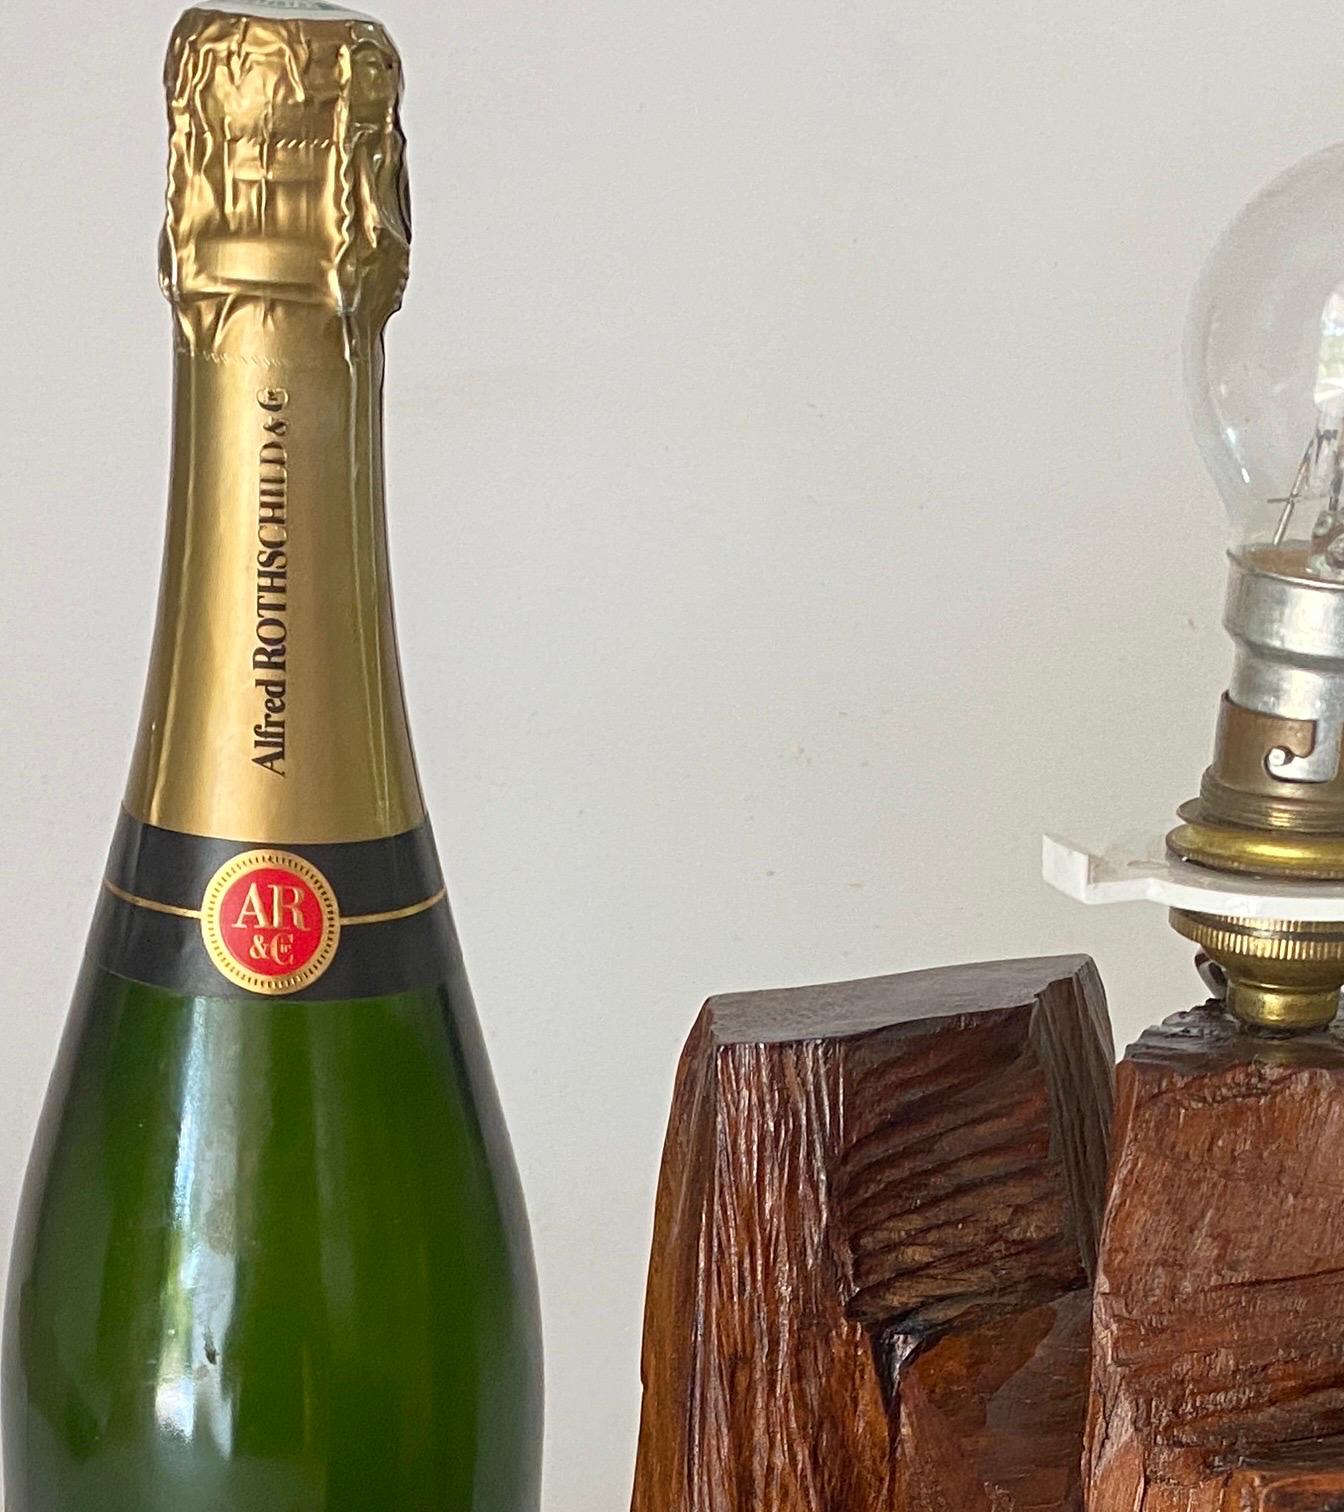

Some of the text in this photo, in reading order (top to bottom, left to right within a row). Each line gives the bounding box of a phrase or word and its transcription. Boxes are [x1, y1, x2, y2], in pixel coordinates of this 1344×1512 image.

[253, 441, 288, 672] ROTHSCHILD
[251, 676, 286, 778] Alfred
[232, 882, 311, 931] AR
